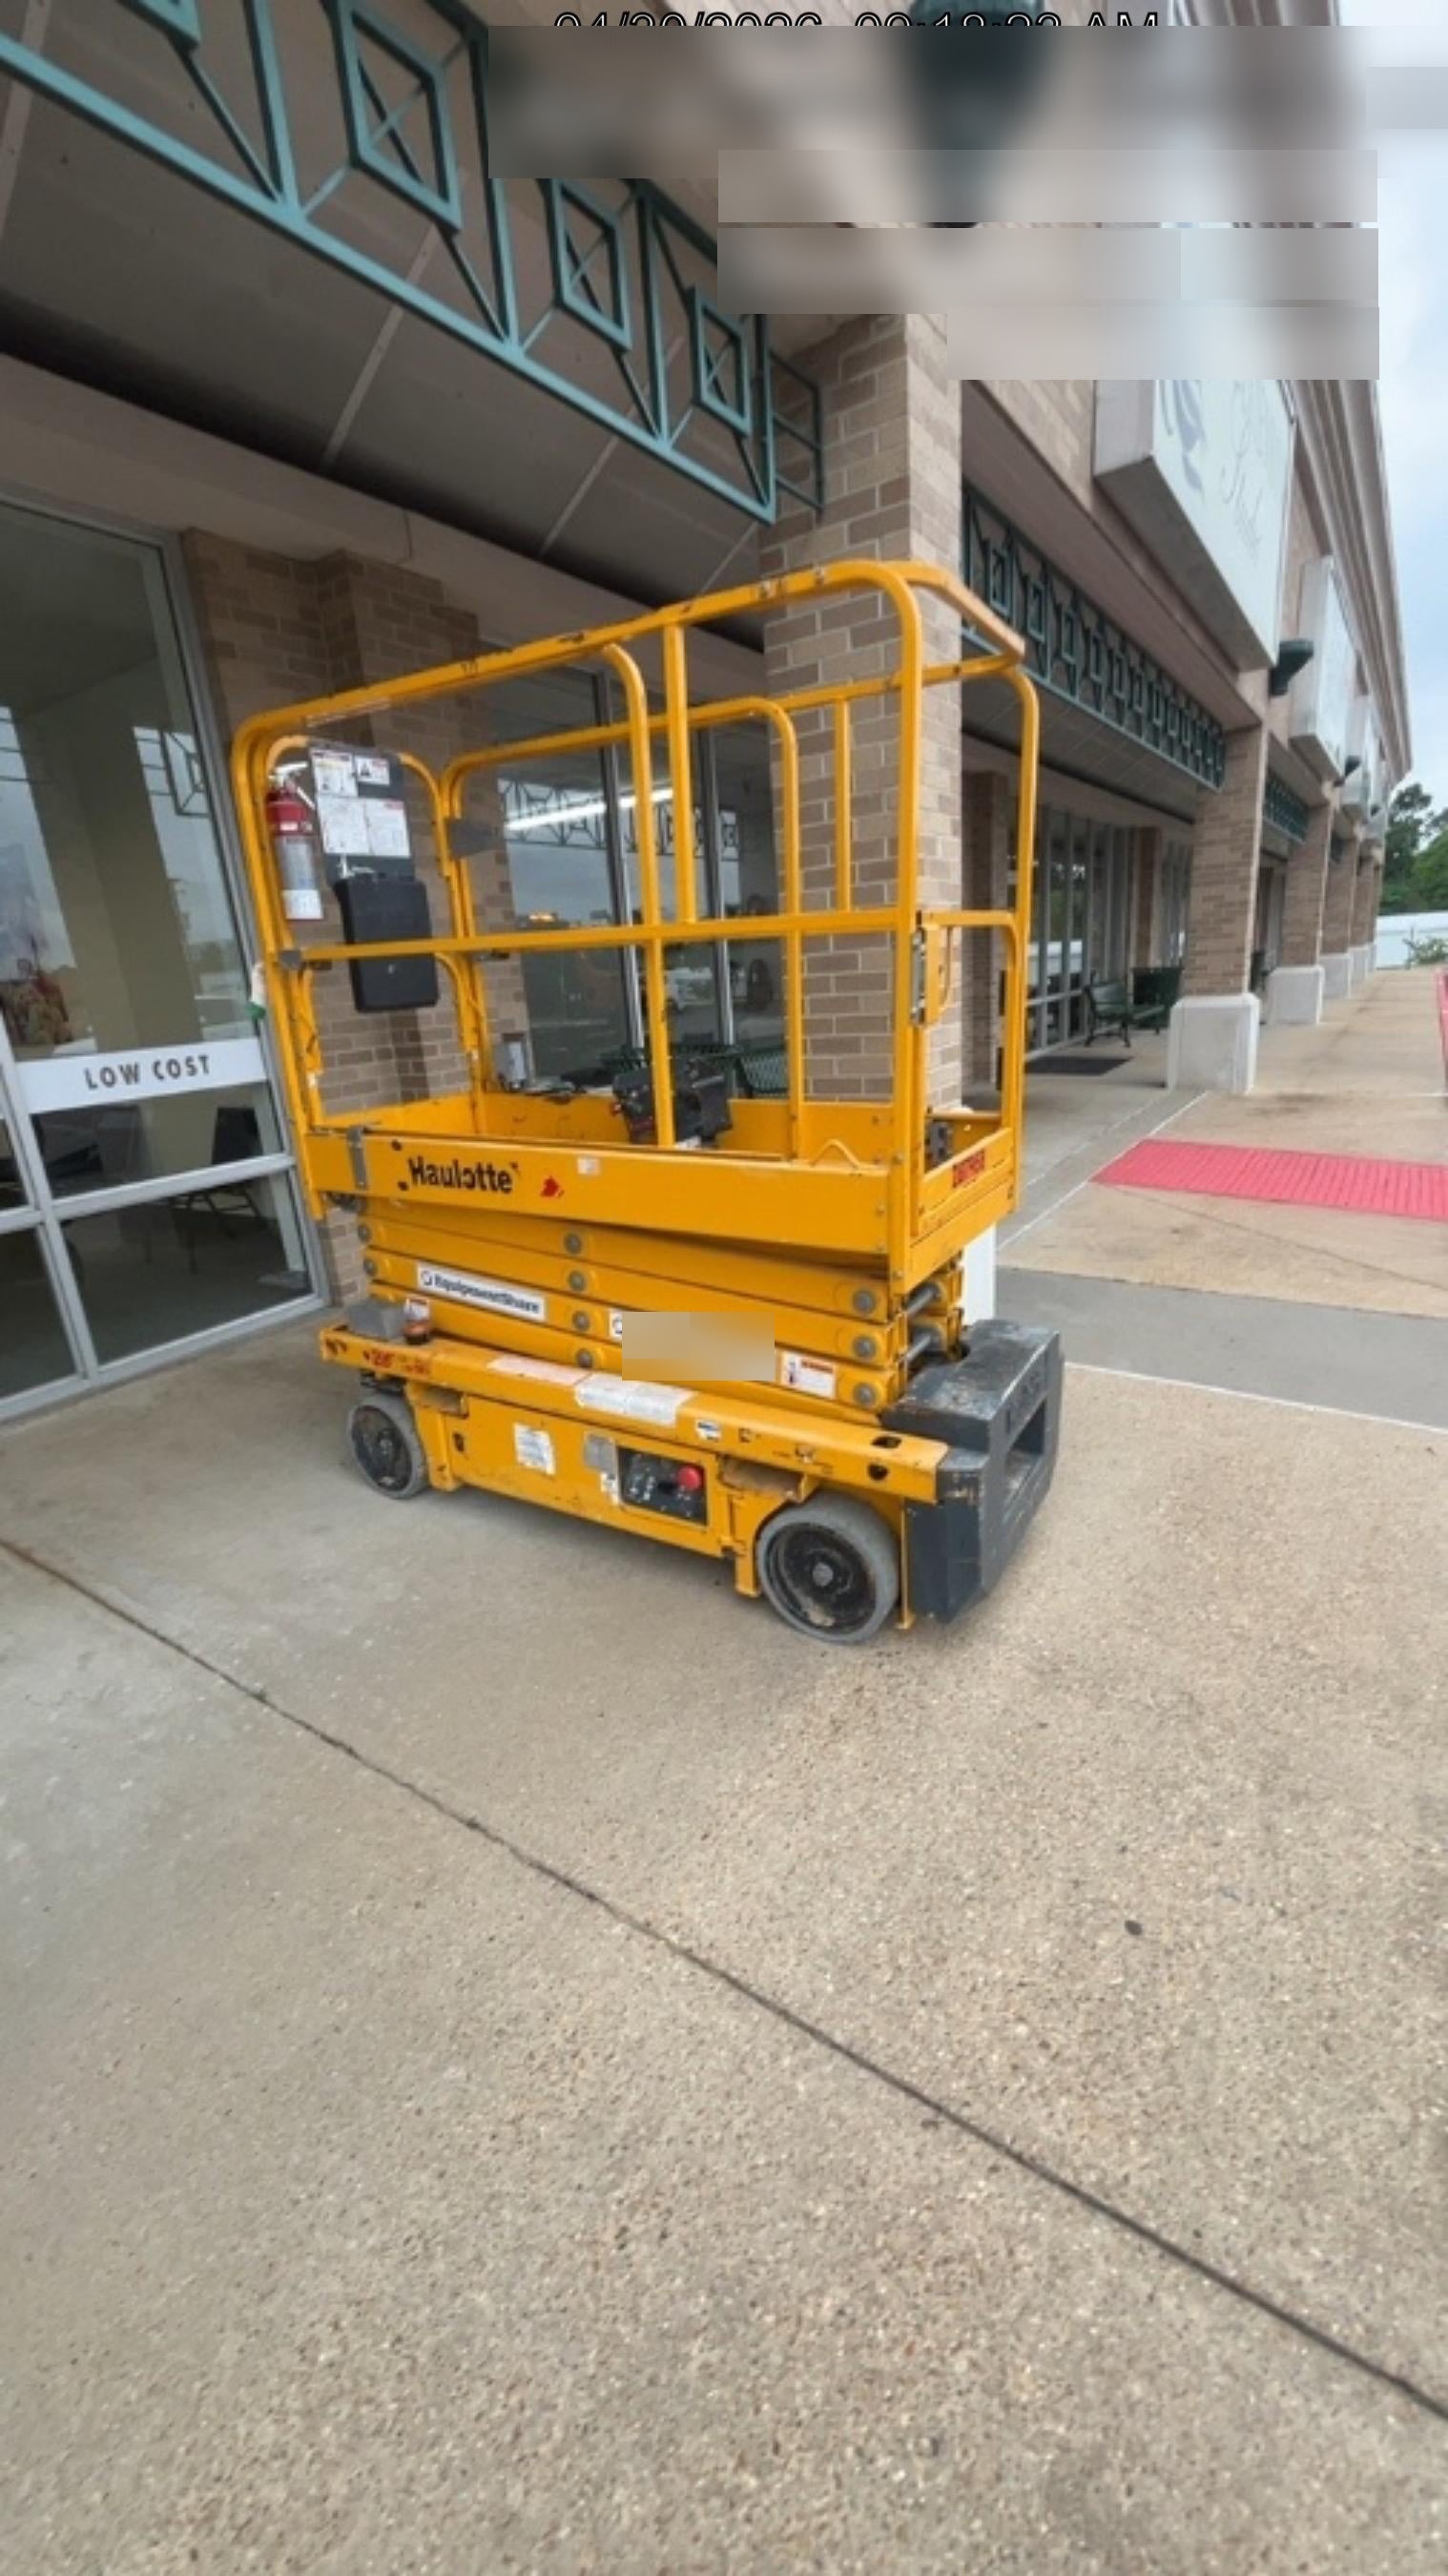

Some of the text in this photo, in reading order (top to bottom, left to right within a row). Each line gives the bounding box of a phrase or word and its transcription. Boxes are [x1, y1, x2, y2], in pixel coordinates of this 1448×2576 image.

[84, 1052, 210, 1090] LOW COST
[407, 1155, 512, 1194] Haulotte
